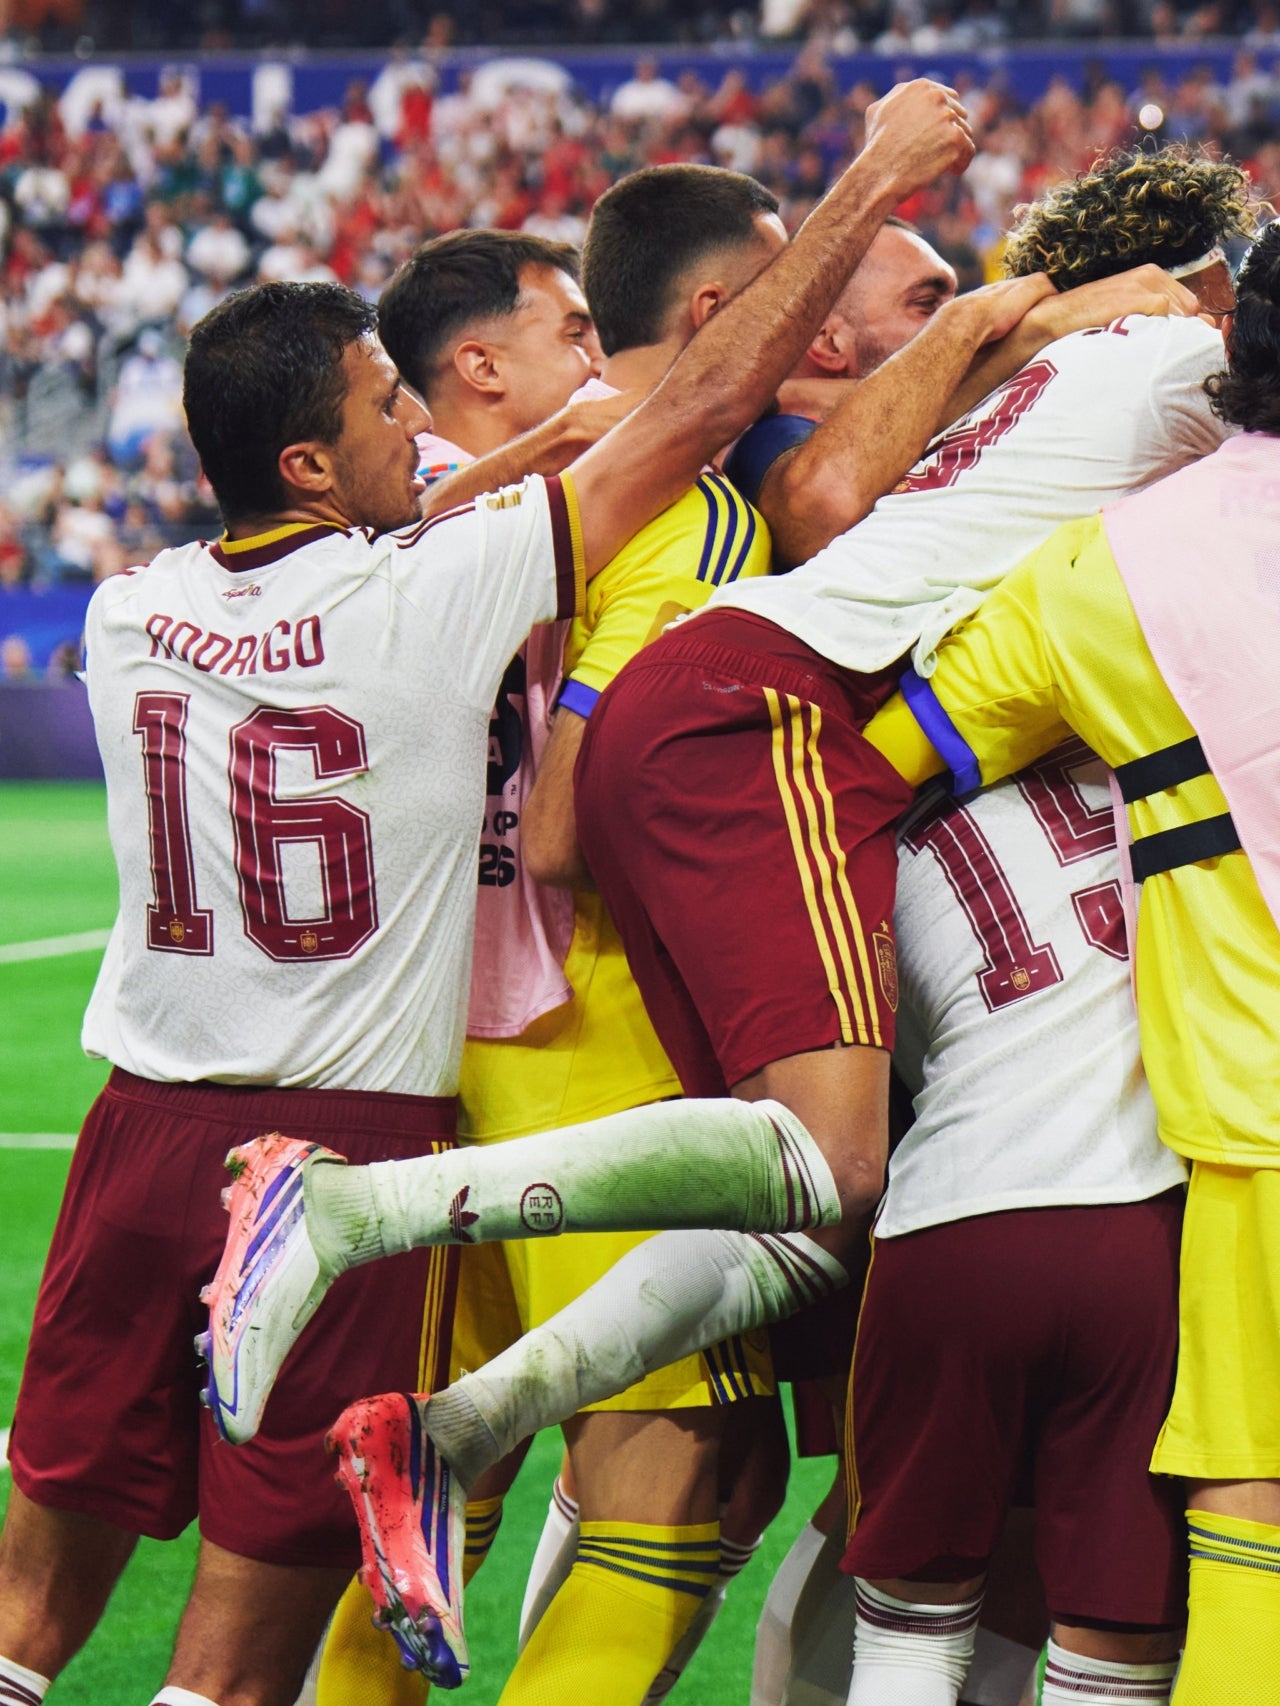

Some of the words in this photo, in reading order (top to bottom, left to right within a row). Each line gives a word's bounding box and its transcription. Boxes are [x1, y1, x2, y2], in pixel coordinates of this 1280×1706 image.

[146, 613, 325, 676] RODRIGO
[132, 690, 380, 963] 16
[902, 733, 1130, 1014] 15
